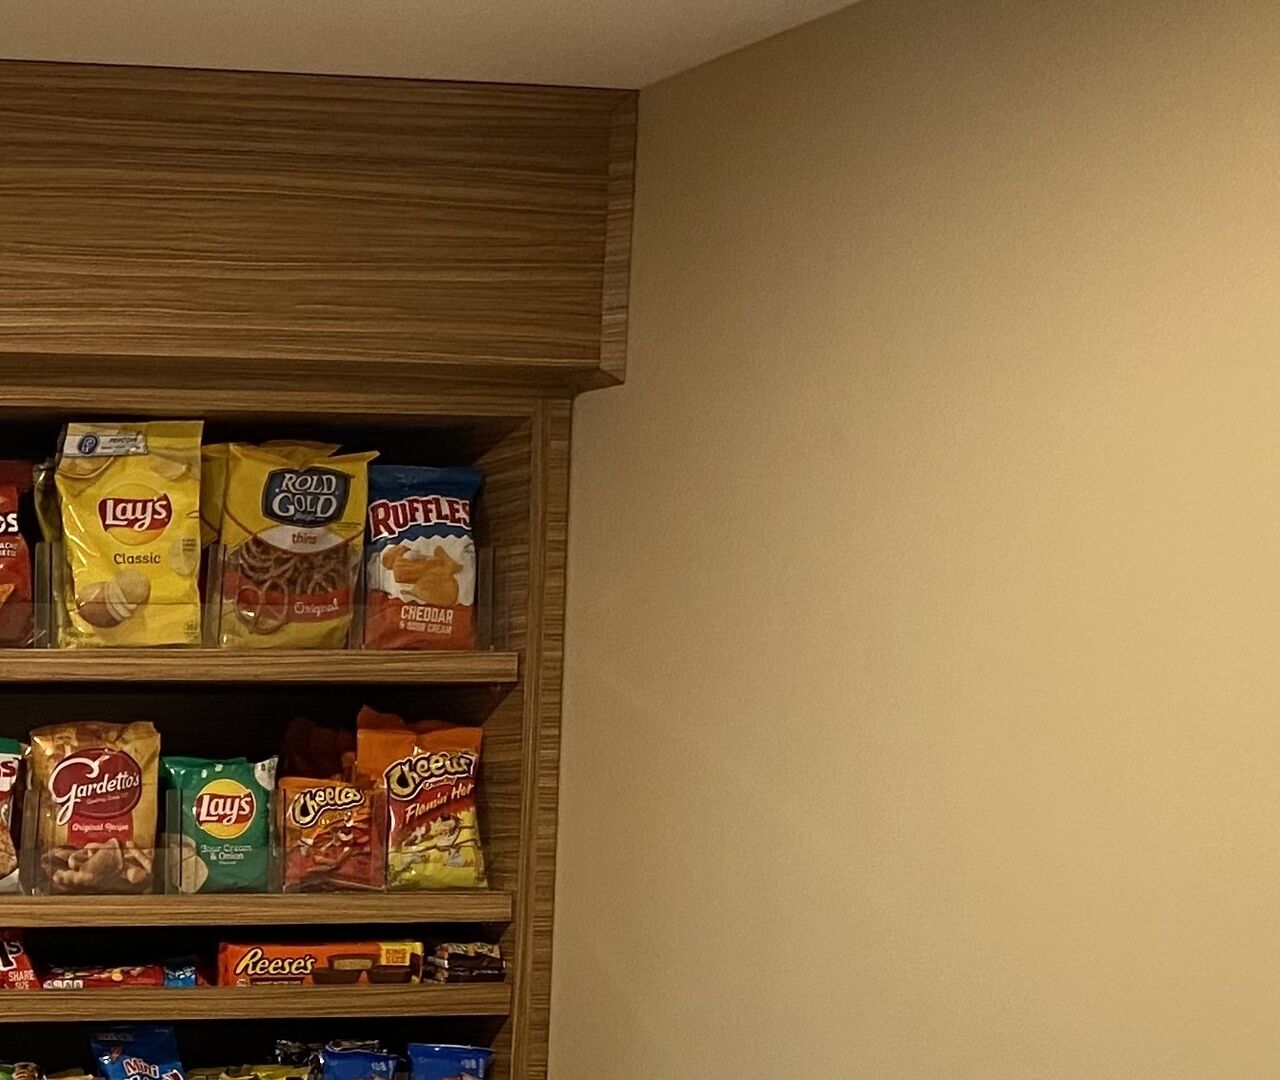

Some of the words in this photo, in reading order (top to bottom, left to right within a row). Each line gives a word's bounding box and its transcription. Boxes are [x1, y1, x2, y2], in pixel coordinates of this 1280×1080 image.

[280, 473, 337, 493] ROLD
[104, 498, 168, 531] Lay's
[272, 492, 338, 518] GOLD
[369, 496, 470, 539] RUFFLES
[291, 531, 318, 545] thins
[113, 552, 161, 565] Classic
[293, 598, 340, 617] Original
[400, 605, 454, 624] CHEDDAR
[427, 624, 452, 634] CREAM
[50, 757, 140, 826] Gardetto's
[450, 782, 475, 800] Hot
[198, 793, 252, 825] Lay's
[72, 822, 104, 833] Original
[105, 823, 129, 832] Recipe
[201, 844, 222, 853] Sour
[223, 844, 252, 852] Cream
[219, 851, 244, 861] Onion
[236, 949, 315, 975] Reese's
[8, 970, 35, 982] SHARE
[123, 1058, 160, 1077] Mini
